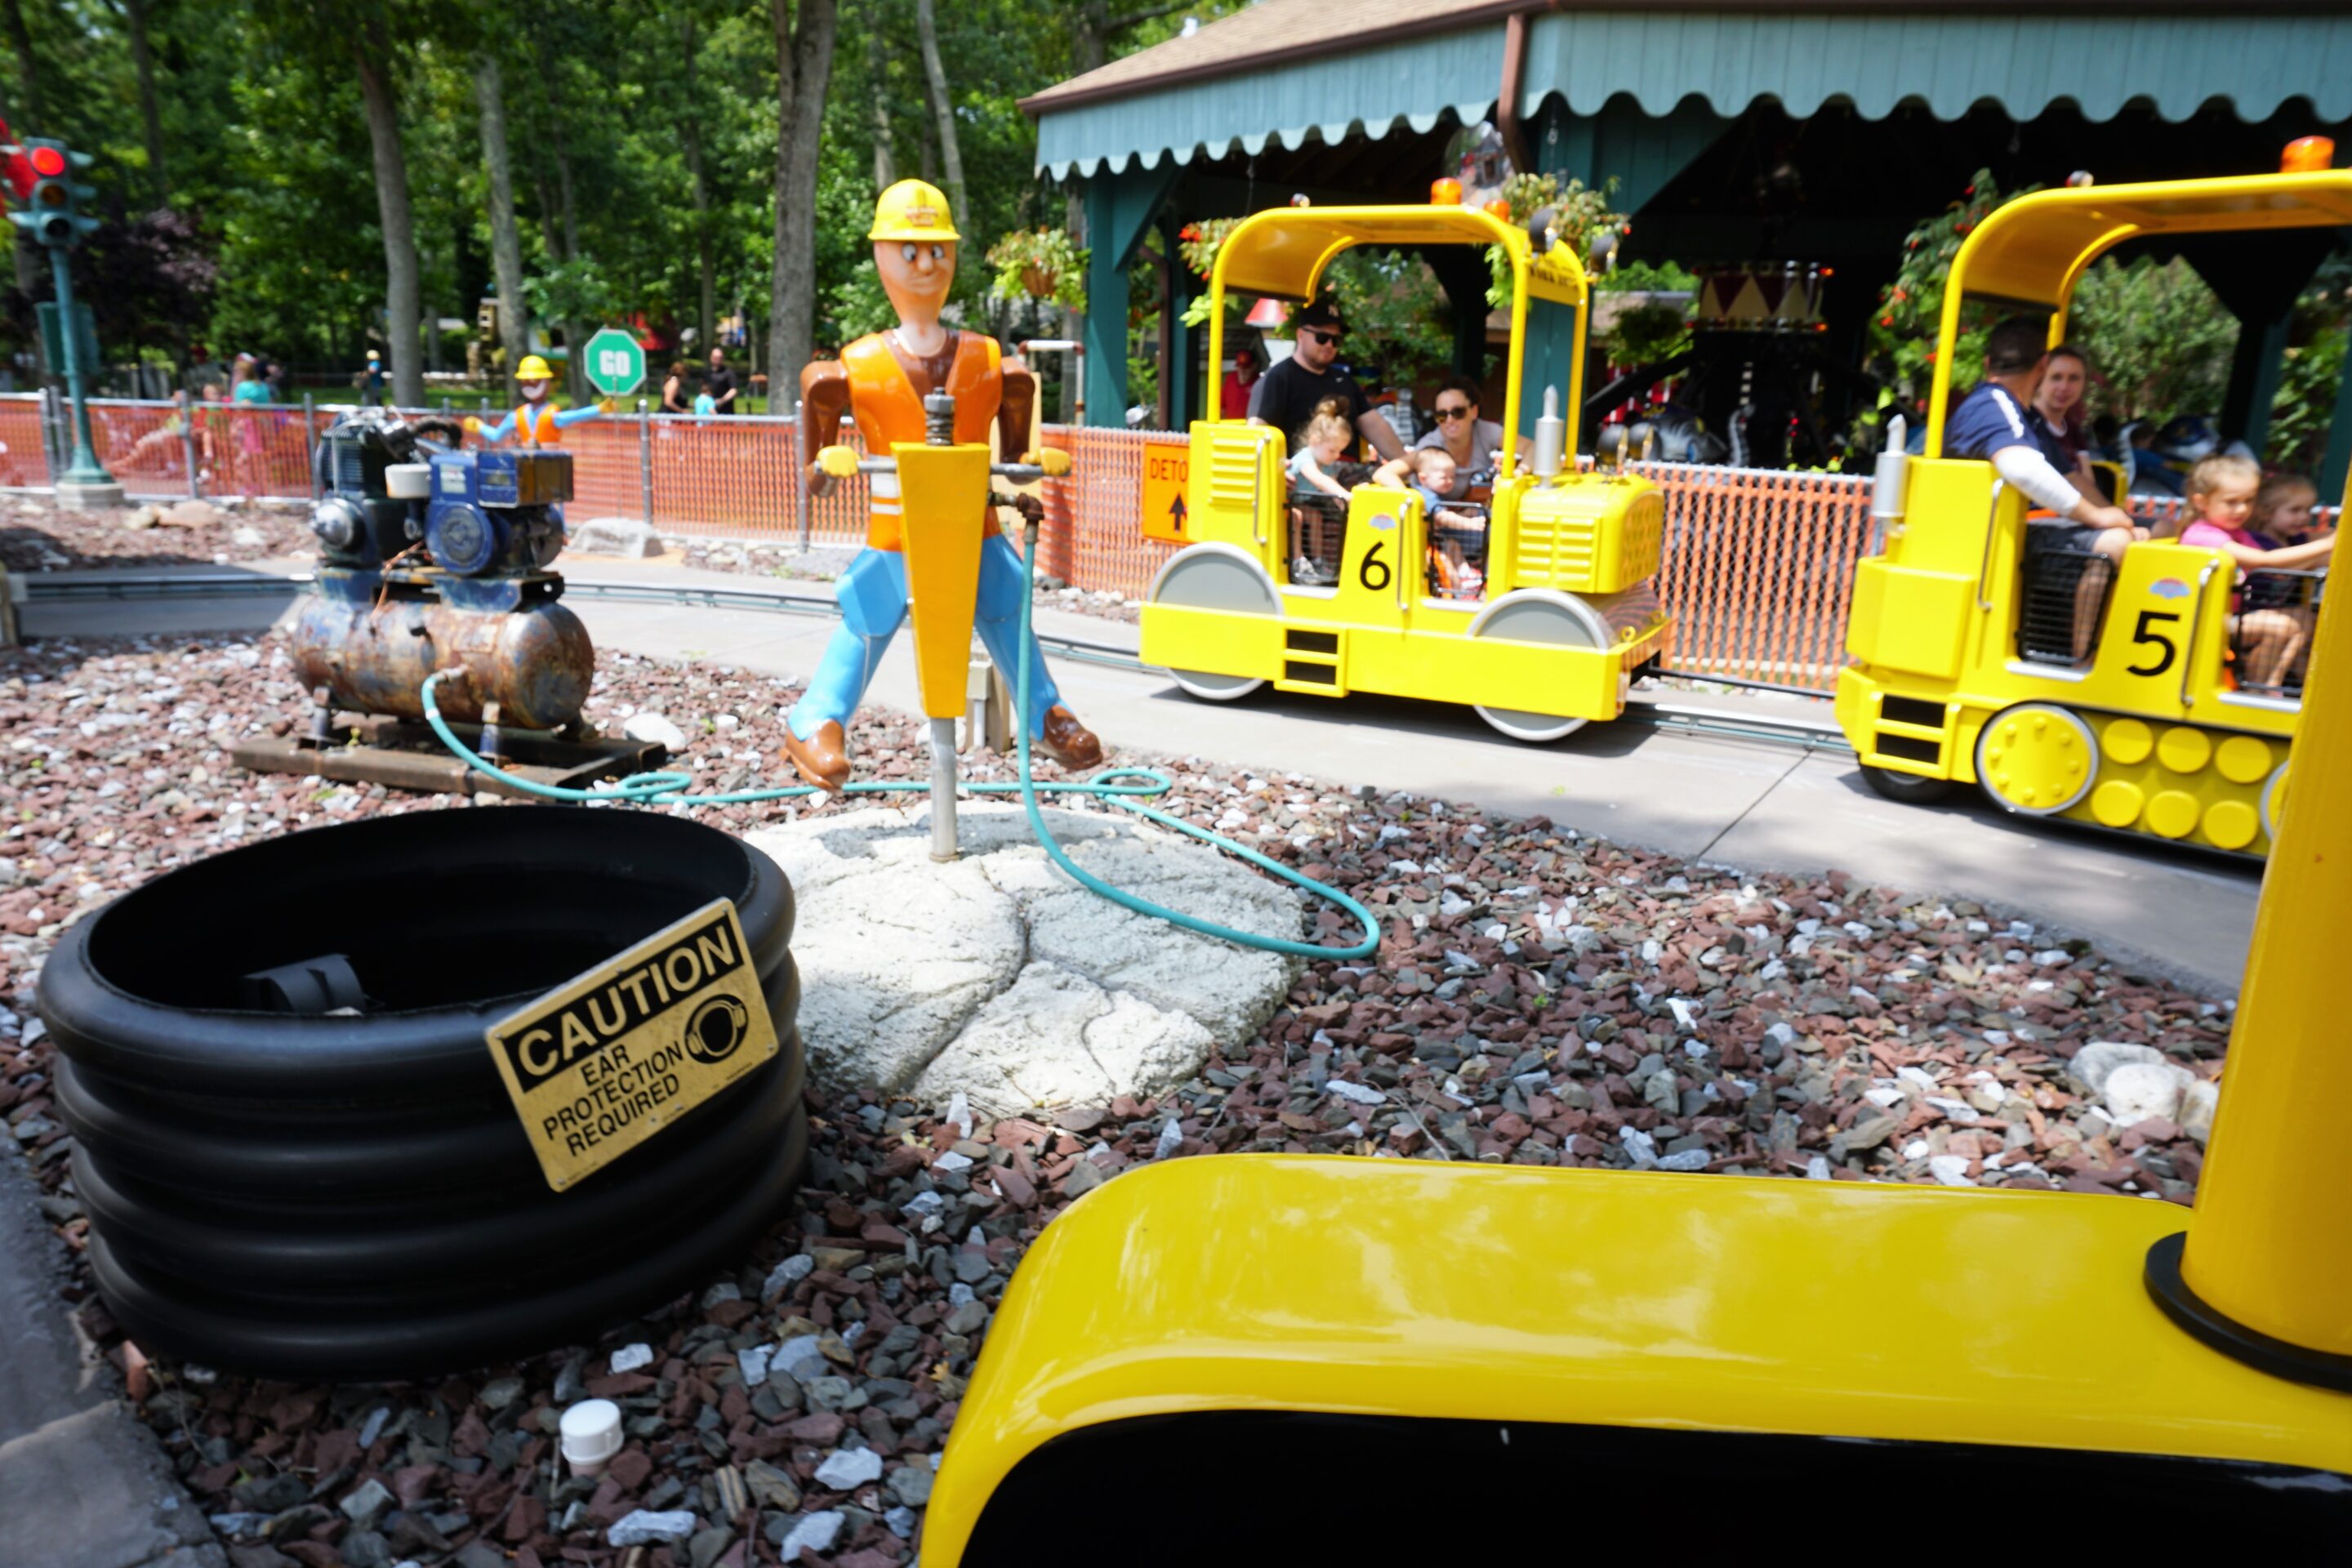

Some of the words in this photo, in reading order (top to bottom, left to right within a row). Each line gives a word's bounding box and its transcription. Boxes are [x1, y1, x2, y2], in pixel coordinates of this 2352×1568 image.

[599, 349, 632, 378] GO
[1359, 540, 1392, 591] 6
[2125, 609, 2181, 678] 5
[518, 924, 736, 1077] CAUTION
[541, 1039, 685, 1141] PROTECTION
[580, 1043, 630, 1087] EAR
[567, 1072, 681, 1157] REQUIRED
